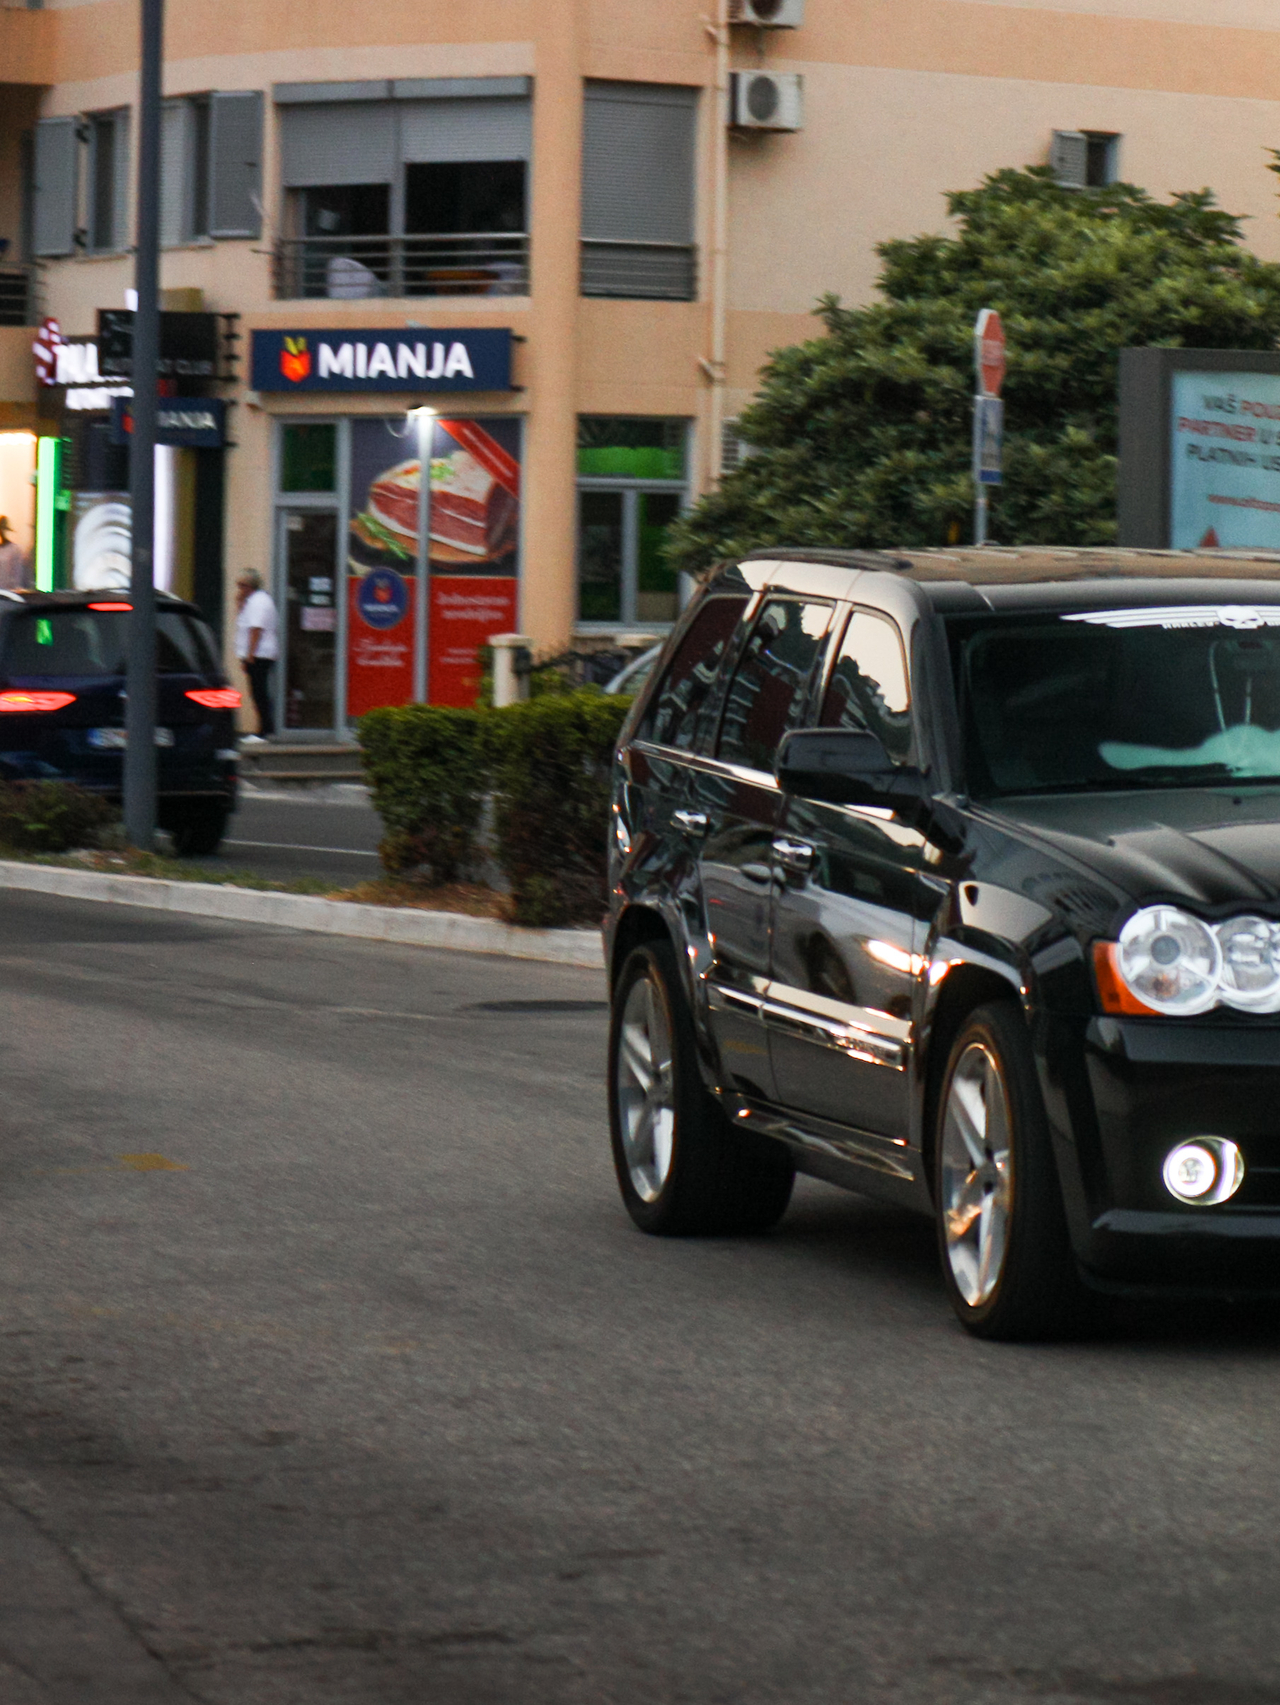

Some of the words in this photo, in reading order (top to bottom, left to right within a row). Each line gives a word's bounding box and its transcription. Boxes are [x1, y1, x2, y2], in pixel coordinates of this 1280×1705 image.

[317, 342, 475, 379] MIANJA
[1203, 393, 1237, 415] VAŠ
[1178, 416, 1256, 442] PARTNER
